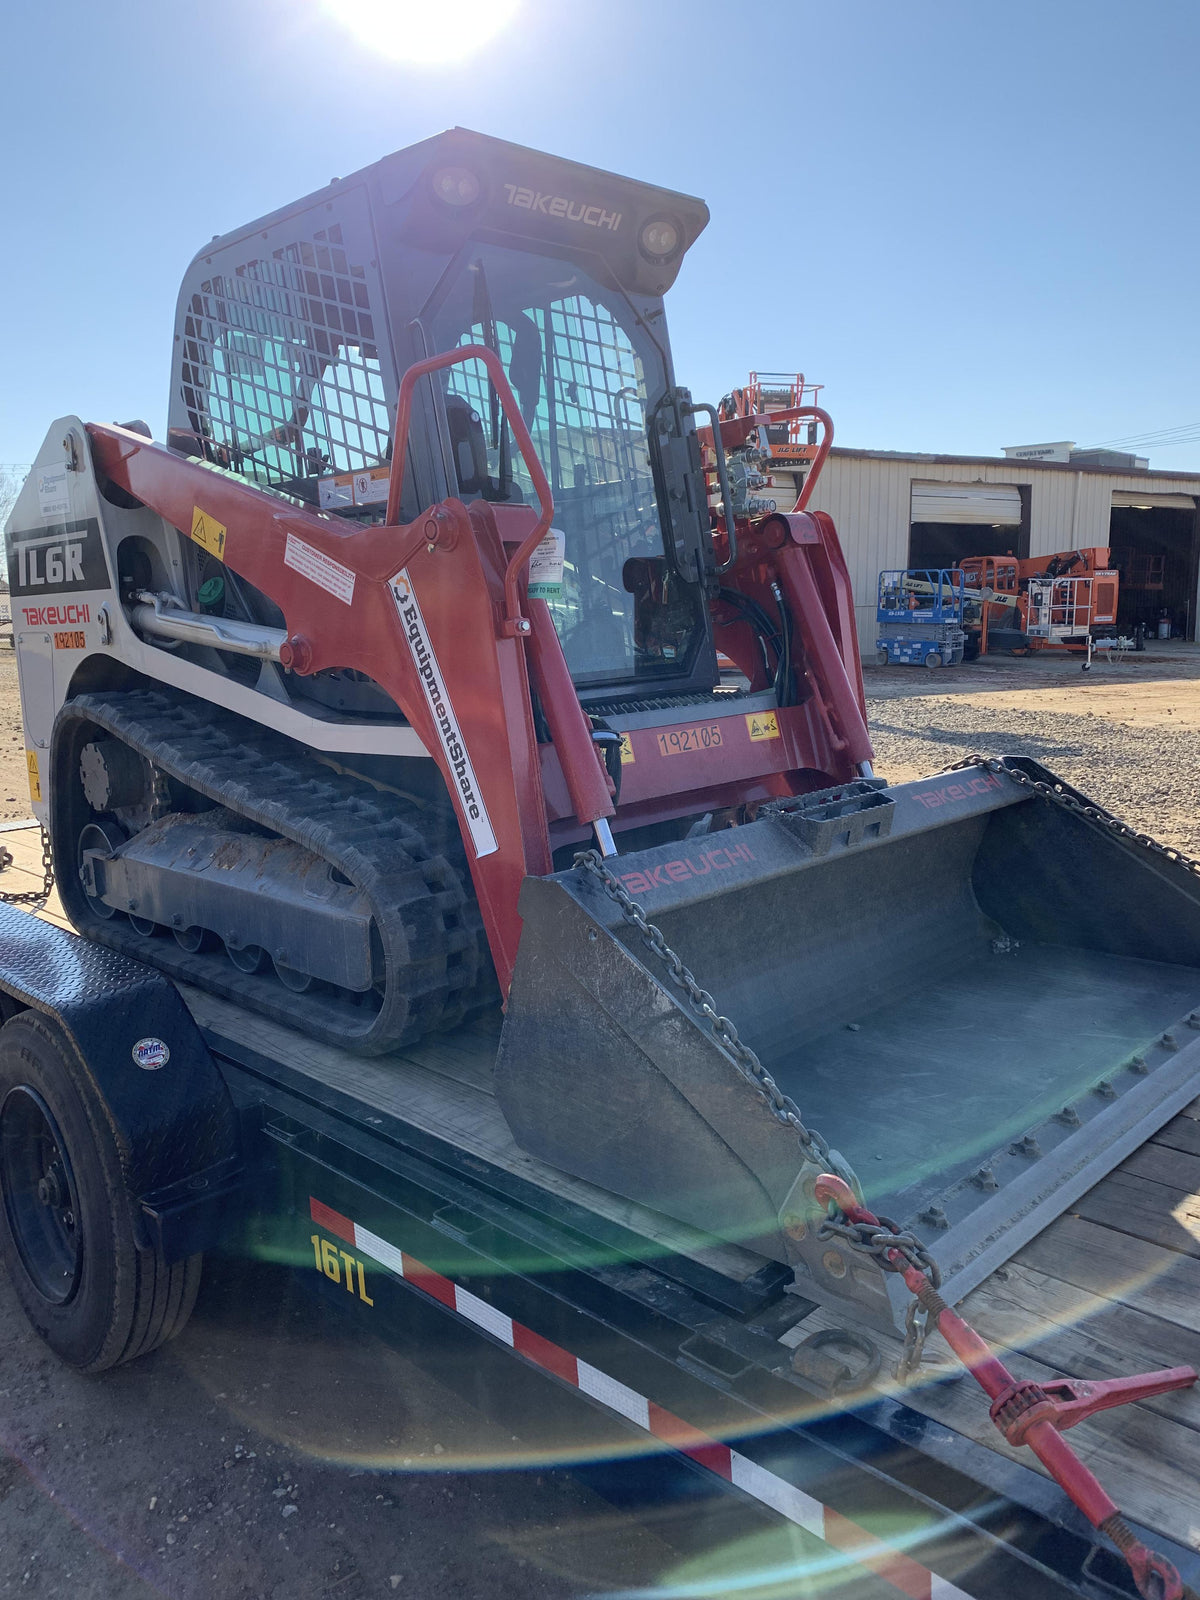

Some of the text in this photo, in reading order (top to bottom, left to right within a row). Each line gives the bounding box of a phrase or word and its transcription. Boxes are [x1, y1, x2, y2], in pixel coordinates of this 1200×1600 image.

[503, 183, 622, 231] TAKEUCHI
[13, 530, 88, 587] TL6R
[22, 604, 90, 625] TAKEUCHI
[994, 595, 1008, 603] JLG
[54, 631, 86, 649] 192105
[403, 603, 481, 821] EquipmentShare
[660, 725, 721, 754] 192105
[912, 774, 1004, 809] TAKEUCHI
[310, 1234, 374, 1307] 16TL
